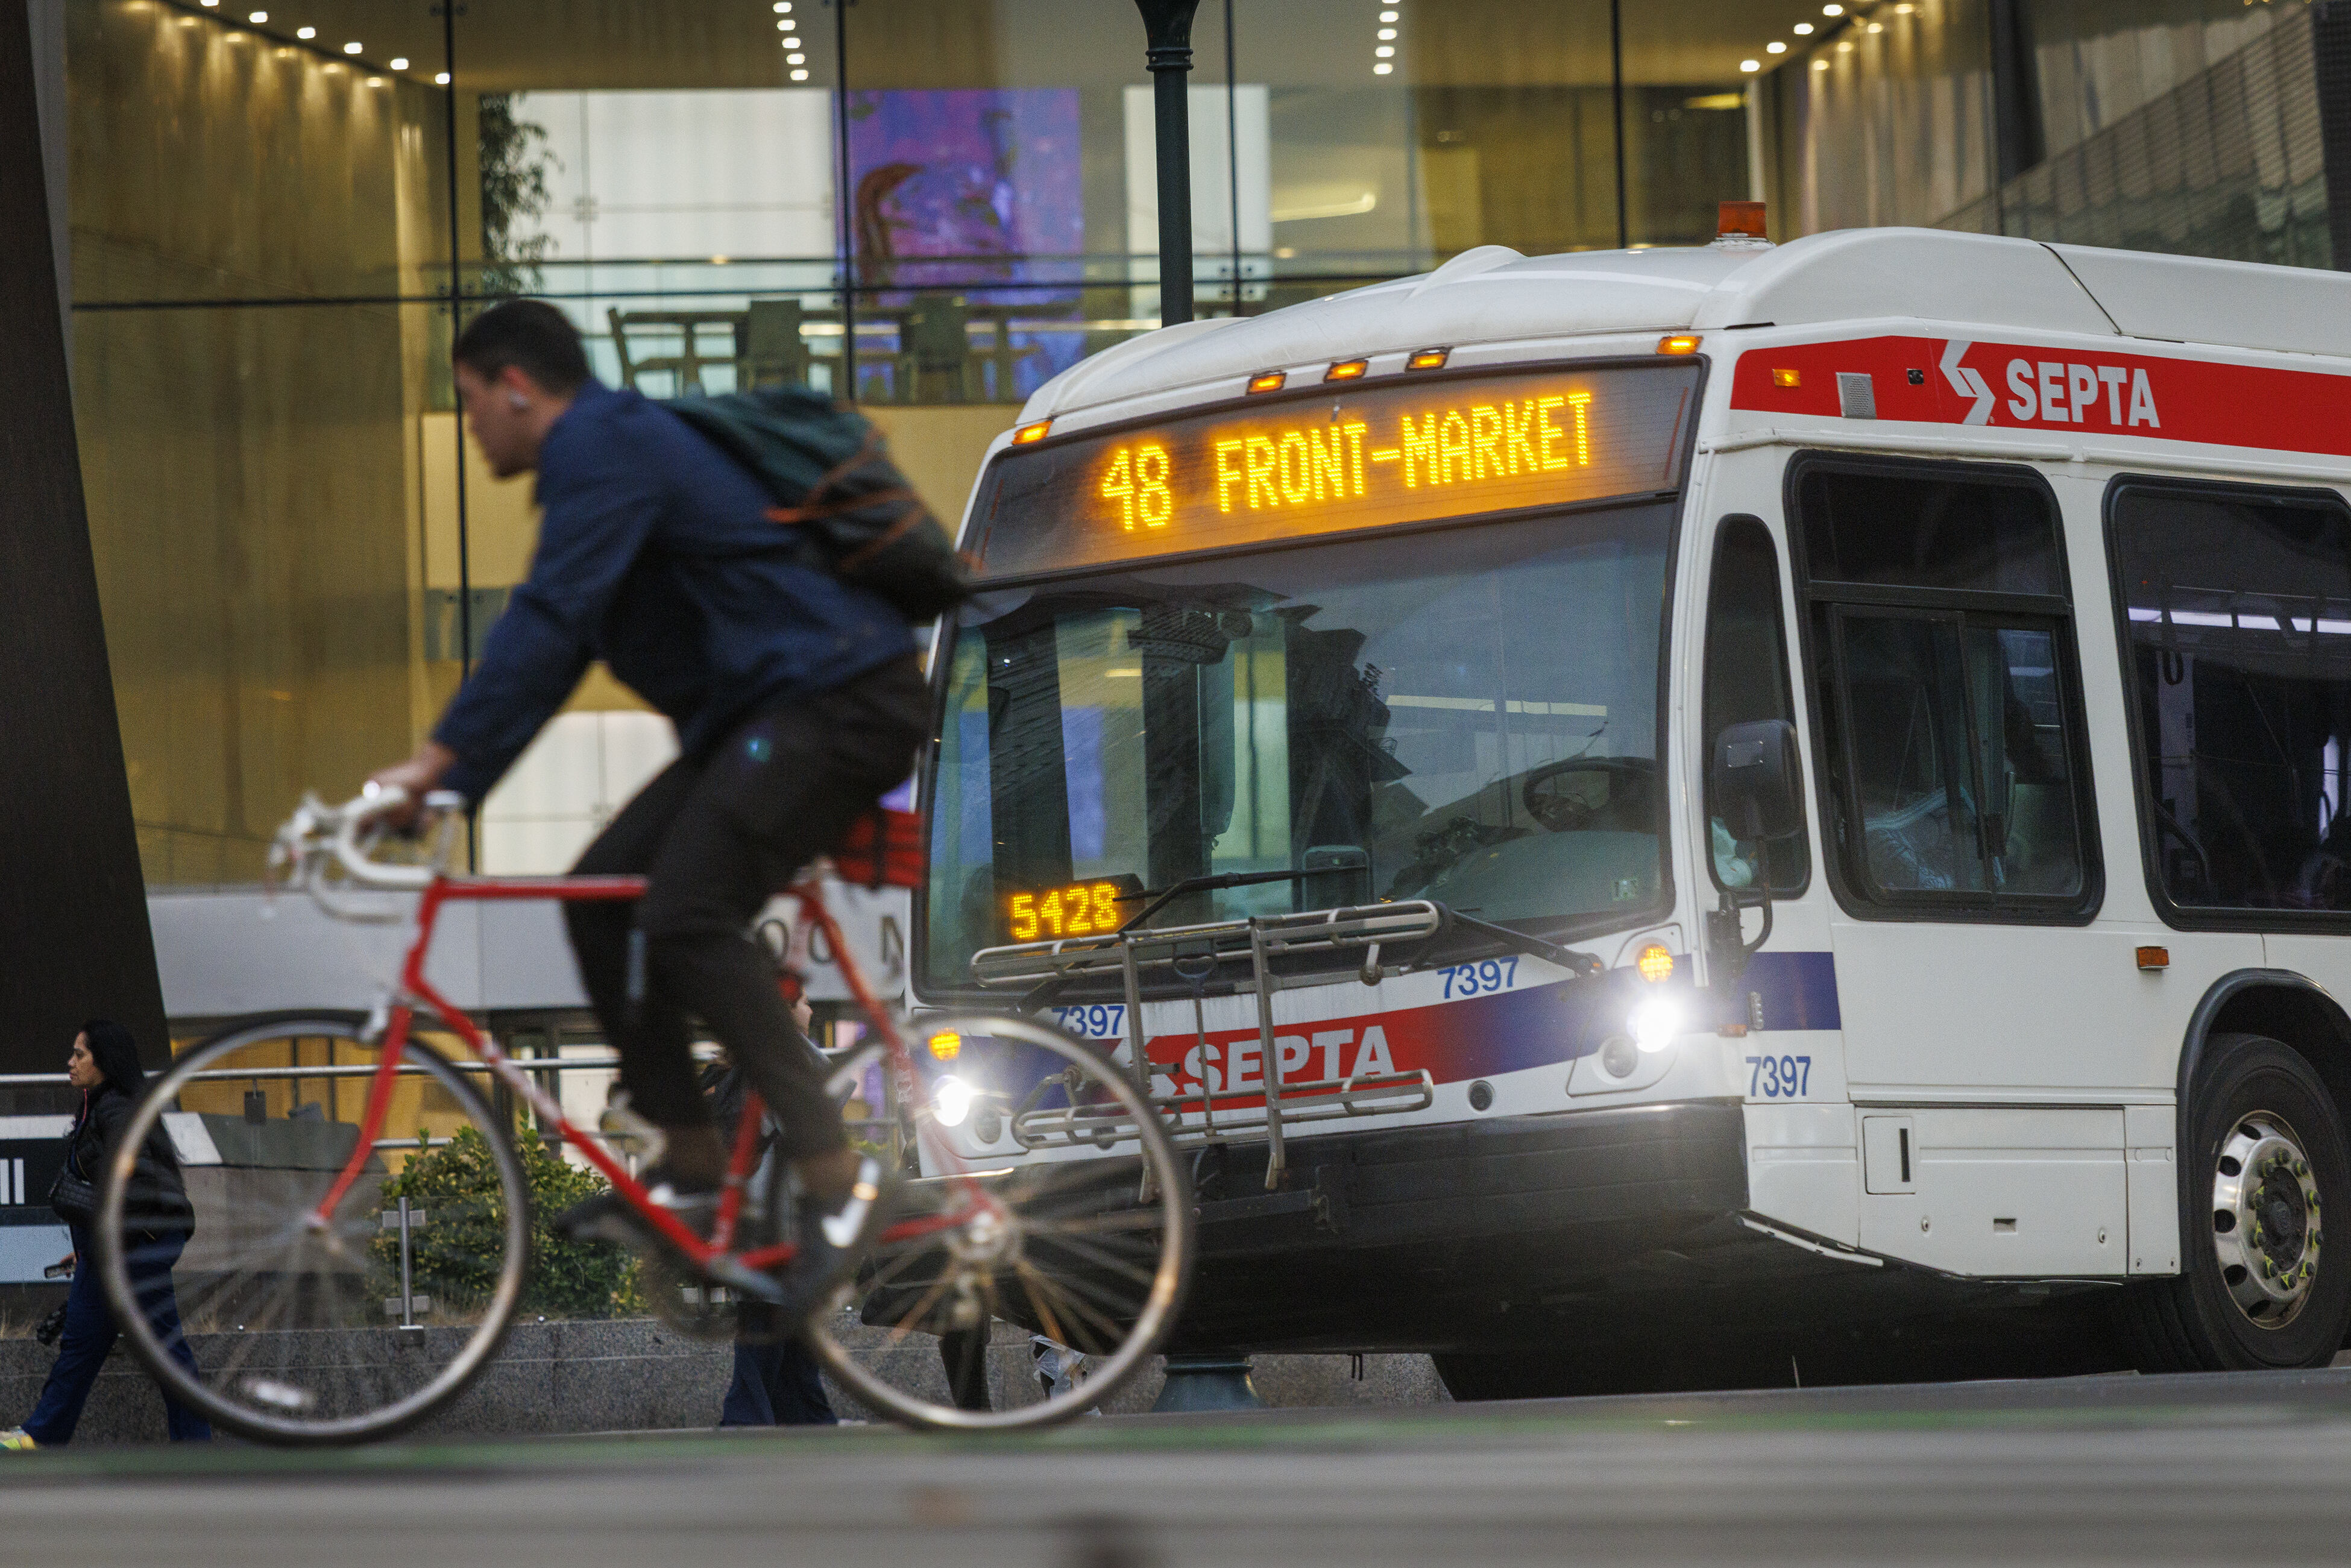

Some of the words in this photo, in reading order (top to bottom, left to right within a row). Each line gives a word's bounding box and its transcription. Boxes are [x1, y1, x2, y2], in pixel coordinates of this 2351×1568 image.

[2006, 358, 2161, 428] SEPTA
[1100, 443, 1174, 532] 48
[1214, 391, 1594, 514] FRONT-MARKET
[1011, 882, 1119, 940] 5428
[1437, 956, 1519, 1000] 7397
[1051, 1004, 1125, 1036] 7397
[1183, 1025, 1396, 1097] SEPTA
[1745, 1056, 1811, 1097] 7397
